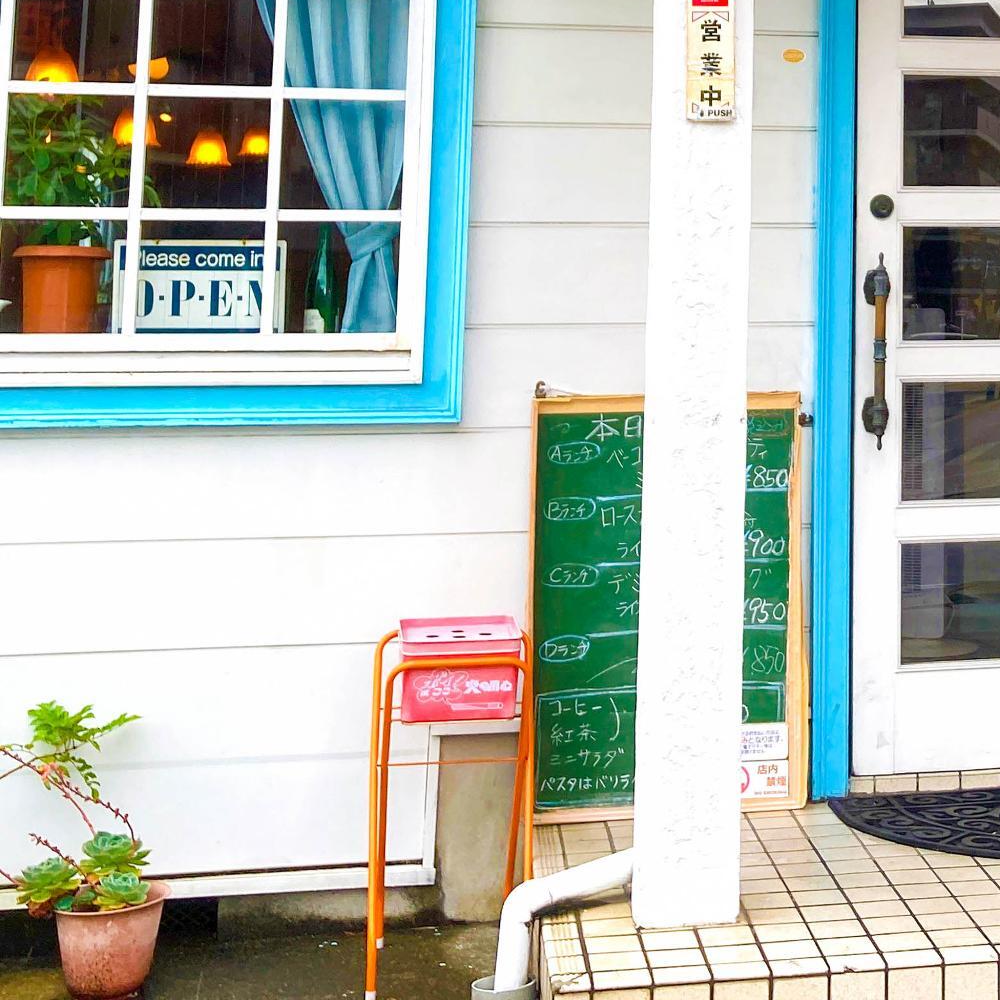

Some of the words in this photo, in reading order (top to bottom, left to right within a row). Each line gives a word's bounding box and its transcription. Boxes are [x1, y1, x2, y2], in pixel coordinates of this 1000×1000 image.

[700, 19, 723, 107] 営業中
[707, 109, 733, 117] PUSH
[138, 250, 190, 267] lease
[195, 252, 246, 267] come
[585, 413, 641, 441] 本日
[601, 505, 641, 527] ロース
[616, 600, 639, 616] ライ
[742, 645, 785, 674] 850
[549, 698, 602, 716] コーヒー
[550, 723, 597, 746] 紅茶
[550, 747, 625, 769] ミニサラダ
[757, 764, 778, 774] 店内
[541, 774, 635, 791] パスタはバリラ
